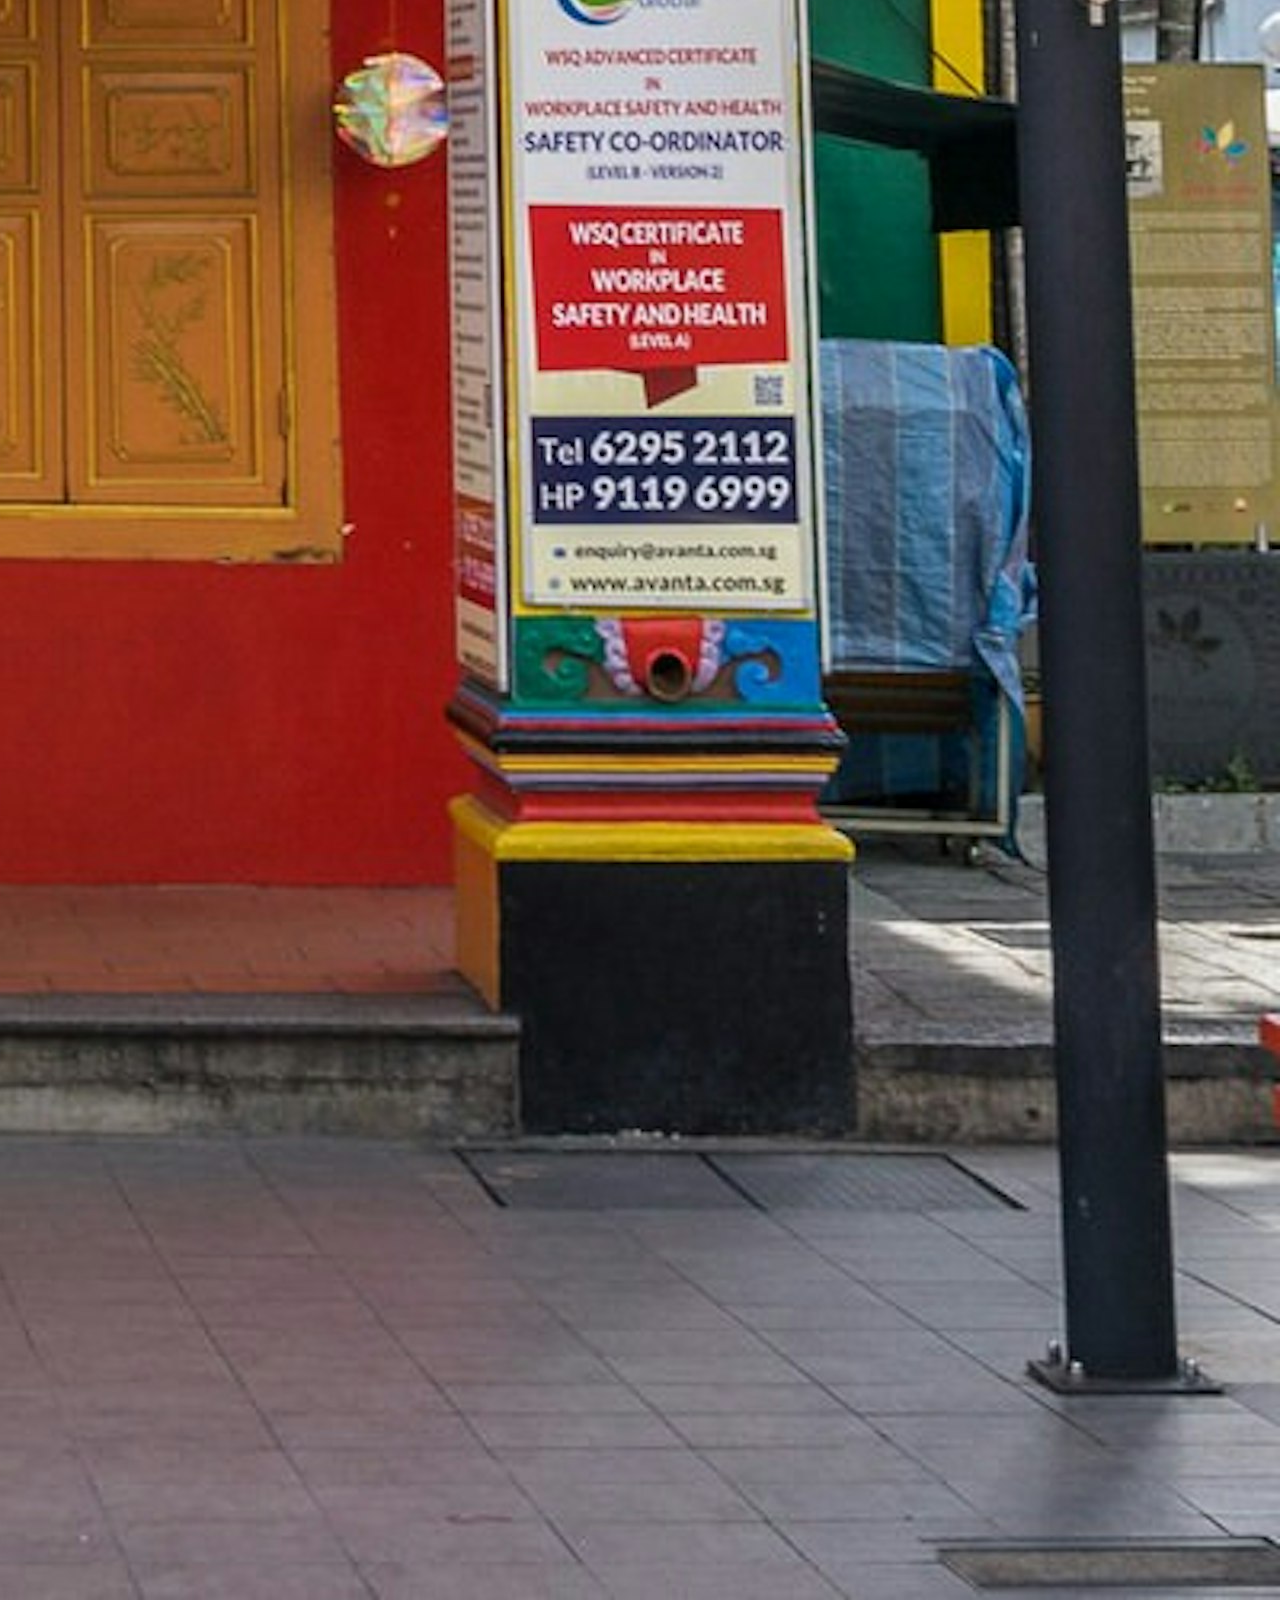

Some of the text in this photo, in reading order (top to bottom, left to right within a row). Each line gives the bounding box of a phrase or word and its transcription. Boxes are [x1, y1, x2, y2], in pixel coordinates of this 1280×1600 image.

[544, 49, 758, 67] WSQ ADVANCED CERTIFICATE
[524, 100, 782, 117] WORKPLACE SAFETY AND HEALTH
[523, 130, 784, 153] SAFETY CO-ORDINATOR
[568, 221, 745, 248] WSQ CERTIFICATE
[647, 249, 667, 265] IN
[590, 267, 726, 293] WORKPLACE
[552, 302, 767, 327] SAFETY AND HEALTH
[537, 429, 789, 466] Tel 6295 2112
[540, 474, 790, 511] HP 9119 6999
[574, 541, 779, 562] enquiry@avanta.com.sg
[569, 574, 786, 595] www.avanta.com.sg
